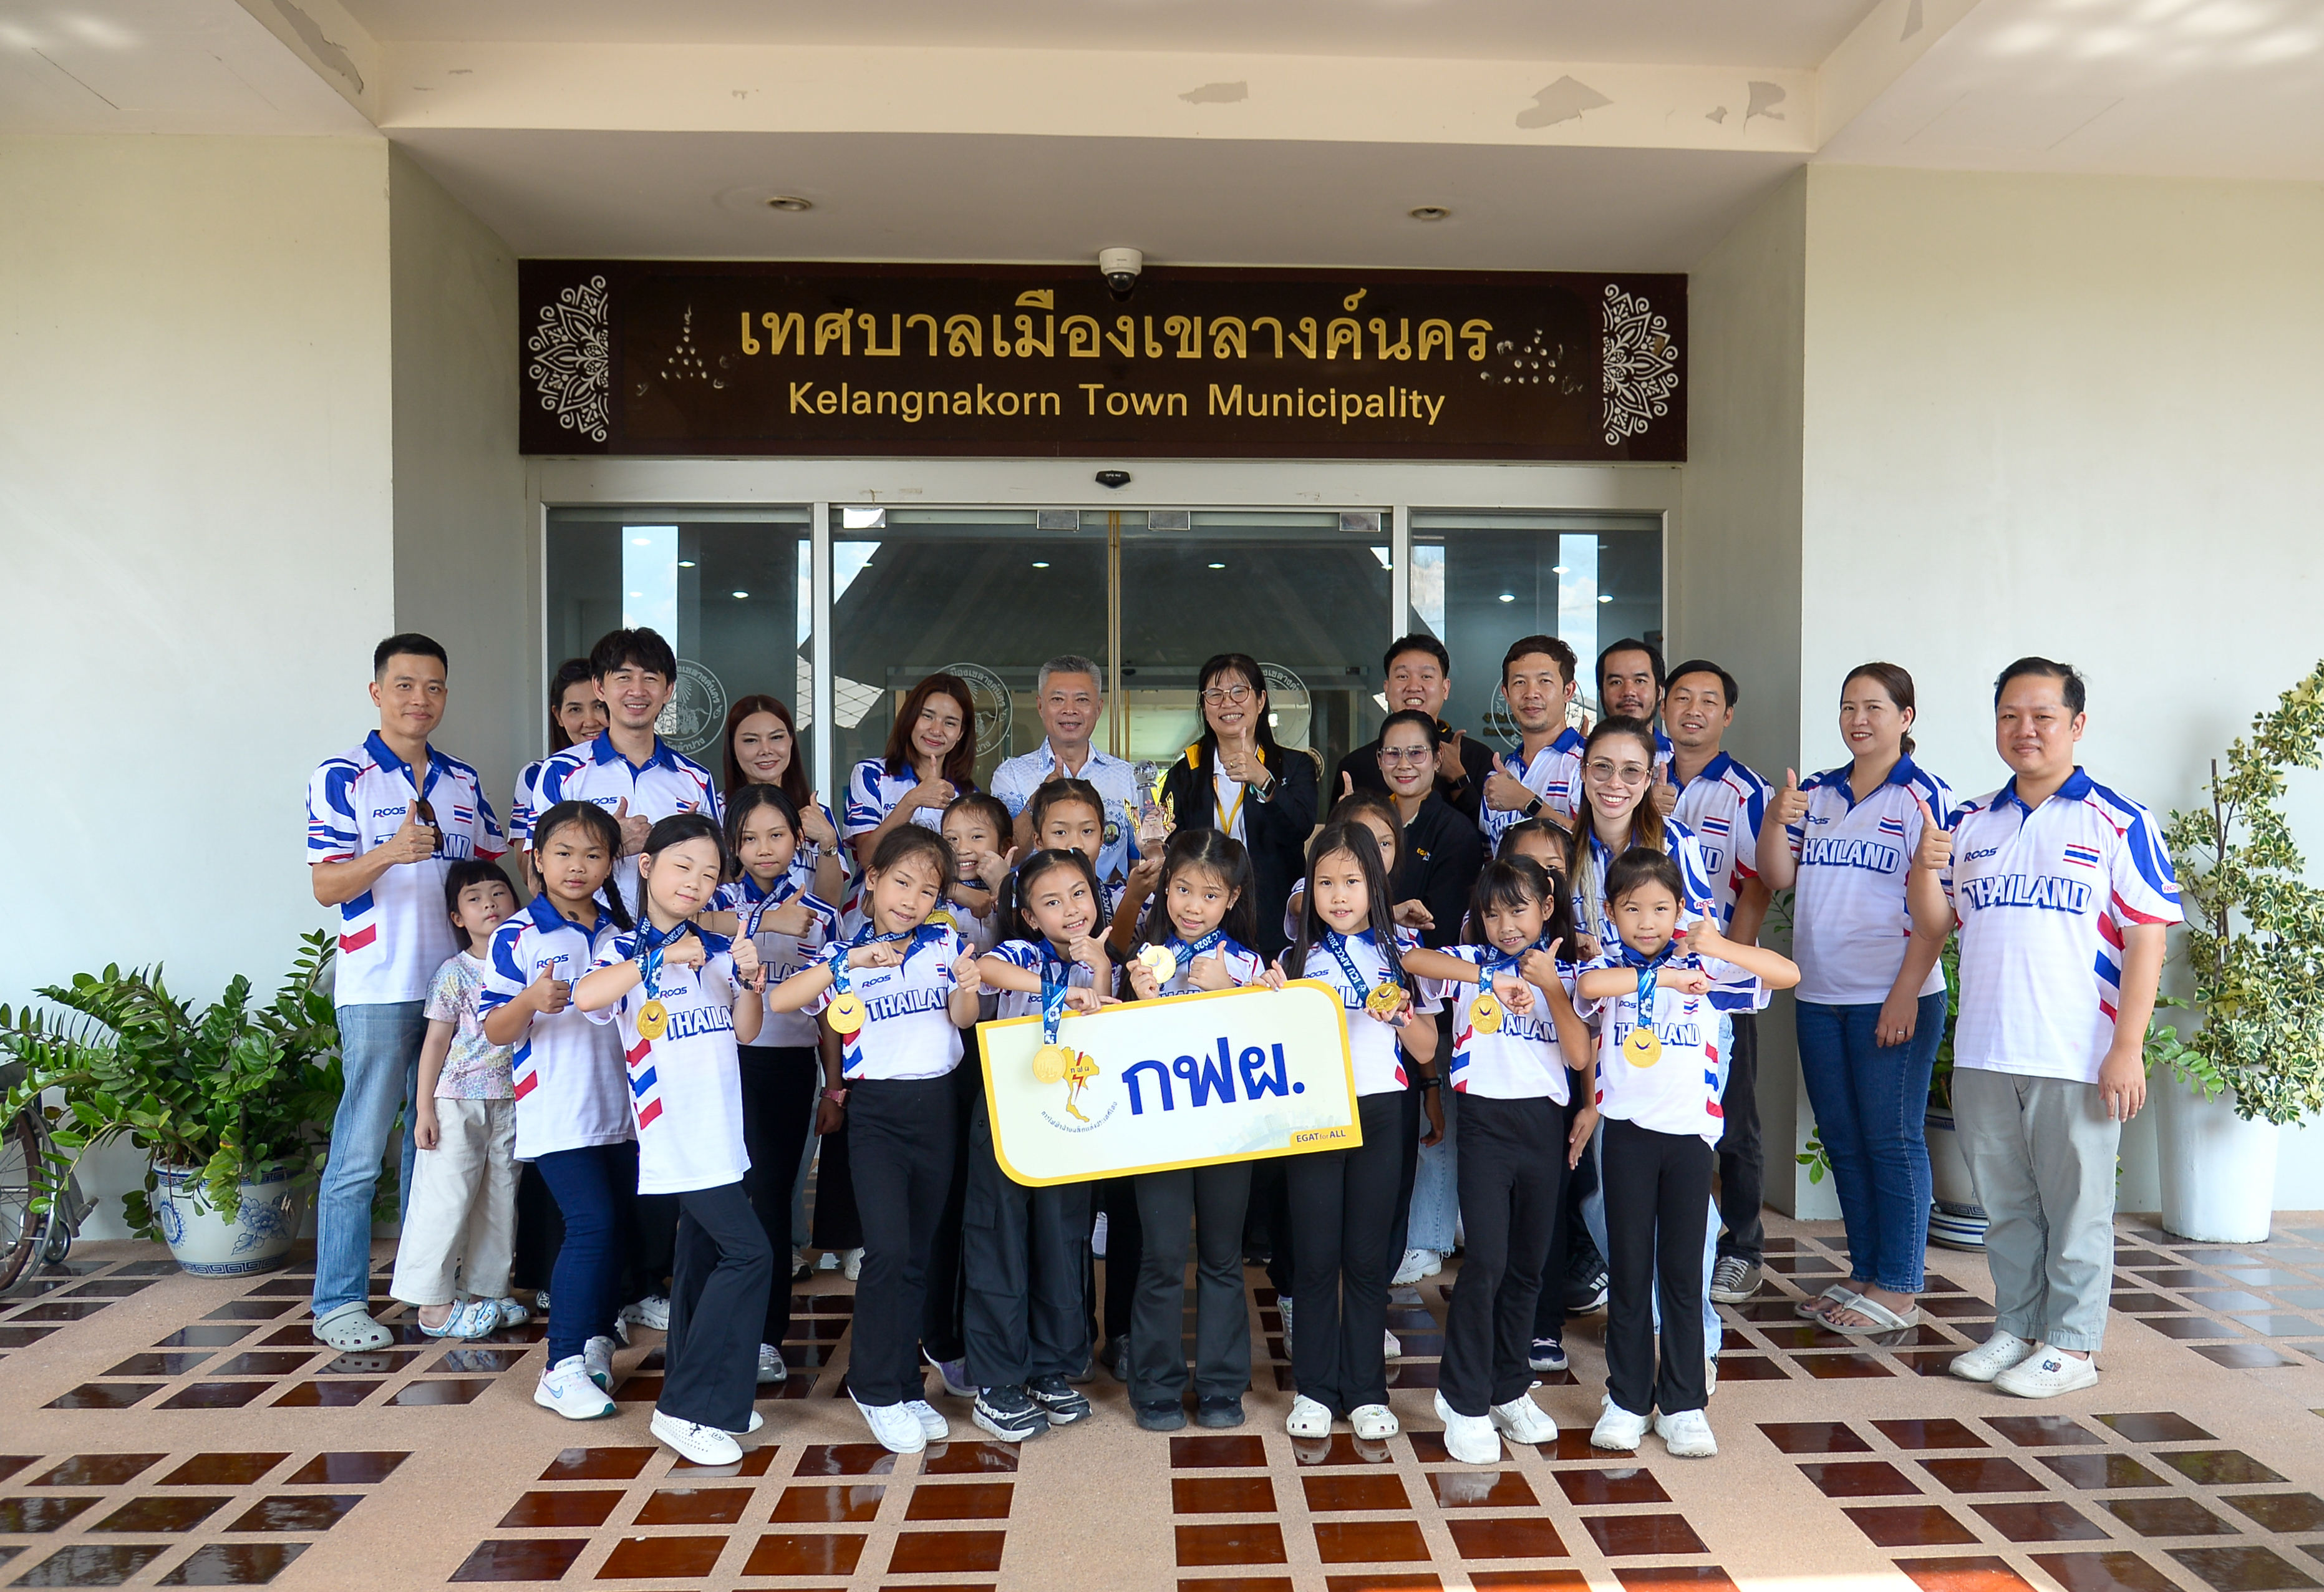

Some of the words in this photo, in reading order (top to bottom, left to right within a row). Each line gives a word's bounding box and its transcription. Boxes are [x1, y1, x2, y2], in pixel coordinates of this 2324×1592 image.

[742, 288, 1493, 361] เทศบาลเมืองเขลางค์นคร
[789, 382, 1062, 424] Kelangnakorn
[1079, 384, 1188, 417] Town
[1209, 384, 1446, 427] Municipality
[372, 807, 406, 818] ROOS
[1799, 838, 1900, 875] HAILAND
[1963, 847, 1998, 862] ROOS
[1962, 874, 2092, 915] THAILAND
[1193, 935, 1213, 951] 2026
[1326, 931, 1340, 949] 2026
[1334, 947, 1352, 968] APCC
[861, 974, 891, 988] ROOS
[1347, 968, 1361, 984] ICU
[660, 986, 687, 999] ROOS
[864, 987, 948, 1022] THAILAN
[1121, 1037, 1305, 1115] กฟผ.
[1296, 1132, 1319, 1142] EGAT
[1329, 1130, 1346, 1138] ALL
